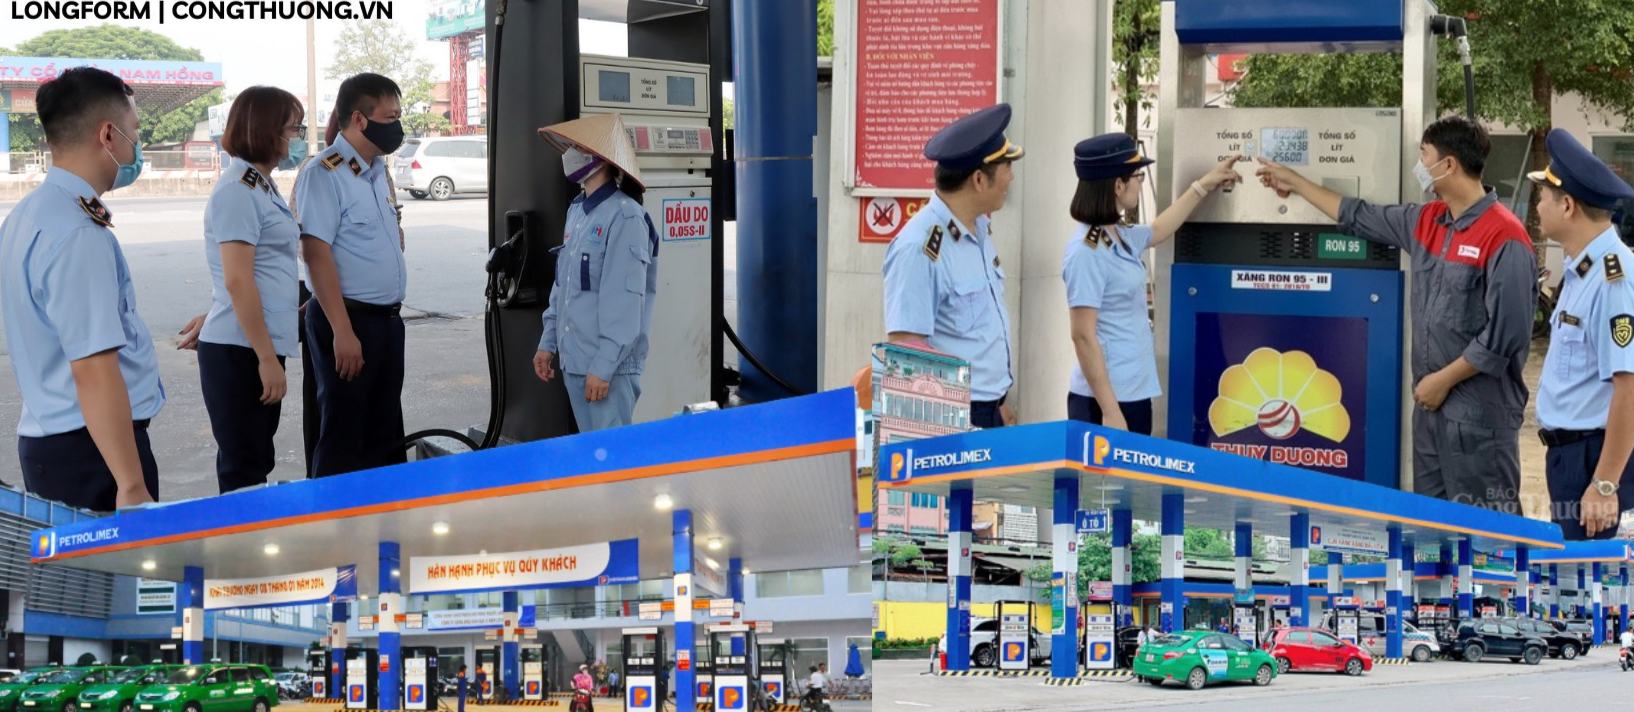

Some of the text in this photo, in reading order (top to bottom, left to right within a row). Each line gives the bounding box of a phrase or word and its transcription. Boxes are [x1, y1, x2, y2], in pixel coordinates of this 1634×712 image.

[118, 69, 160, 79] NAM
[165, 65, 214, 80] HỒNG
[1216, 129, 1253, 139] TỔNG SỐ
[1318, 129, 1356, 140] TỔNG SỐ
[1229, 142, 1240, 151] LÍT
[1331, 142, 1343, 151] LÍT
[1272, 152, 1302, 162] 25600
[665, 201, 709, 224] DẦU DO
[1325, 239, 1360, 253] RON 95
[1236, 272, 1328, 284] XĂNG RON 95 III
[914, 448, 992, 470] PETROLIMEX
[1112, 448, 1196, 474] PETROLIMEX
[1270, 446, 1348, 468] DUONG
[59, 527, 120, 548] PETROLIMEX
[448, 563, 474, 580] HẠNH
[476, 562, 500, 578] PHỤC
[503, 560, 516, 577] VỤ
[518, 556, 538, 573] QUÝ
[542, 554, 577, 572] KHÁCH
